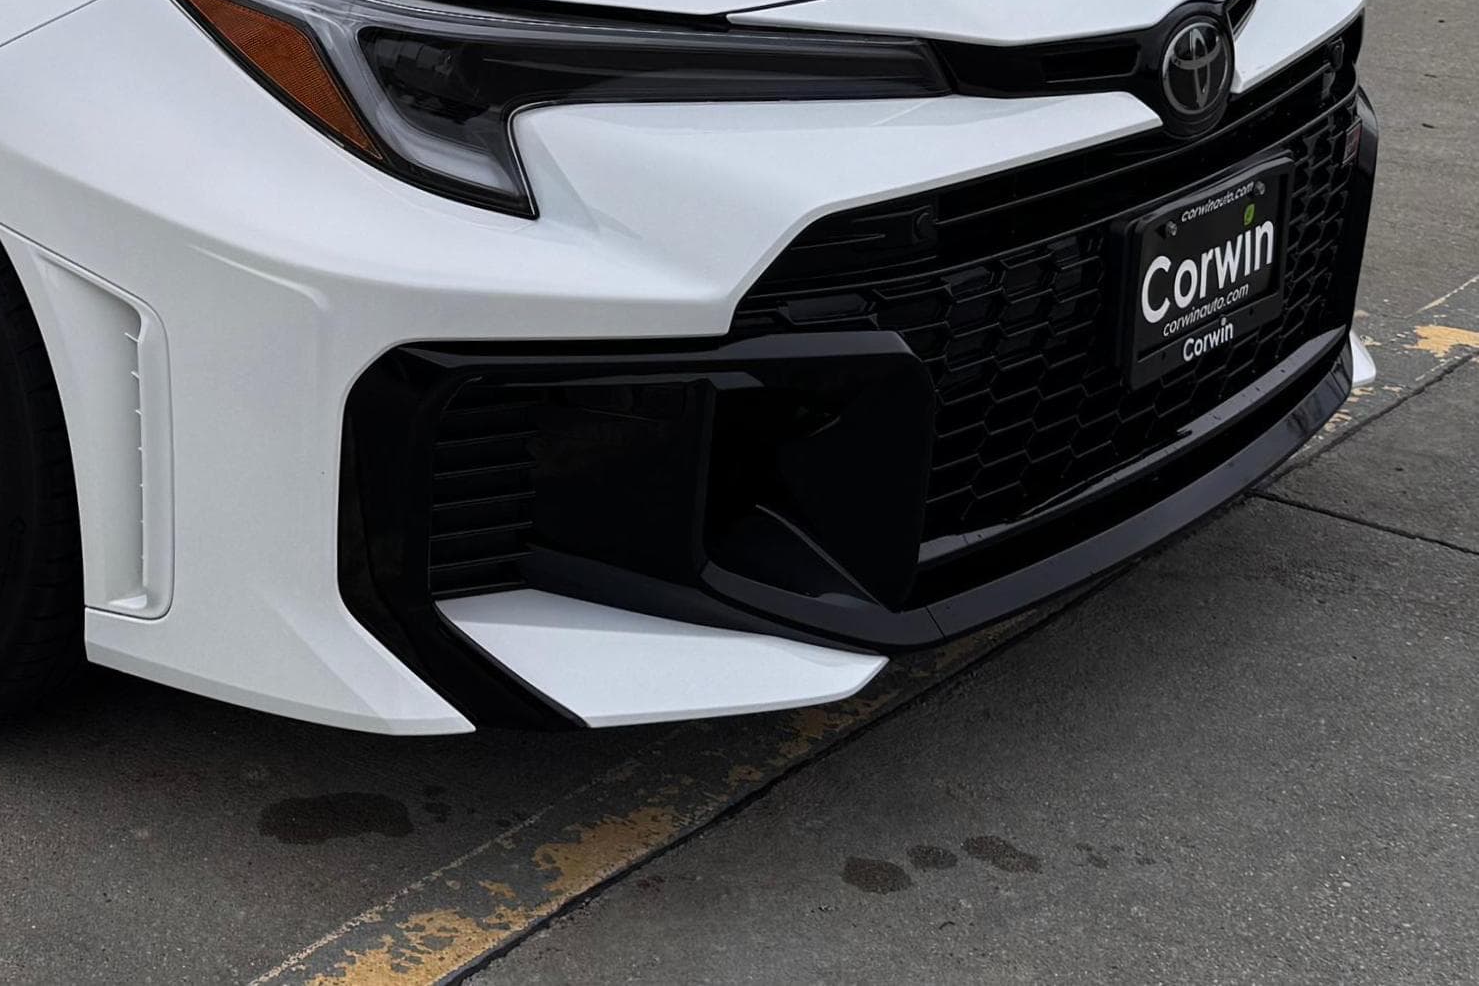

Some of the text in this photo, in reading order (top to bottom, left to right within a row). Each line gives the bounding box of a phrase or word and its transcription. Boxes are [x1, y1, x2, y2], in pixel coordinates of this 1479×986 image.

[1181, 181, 1254, 222] corwinauto.com
[1141, 204, 1274, 324] Corwin
[1163, 284, 1249, 337] corwinauto.com
[1183, 317, 1233, 362] Corwin
